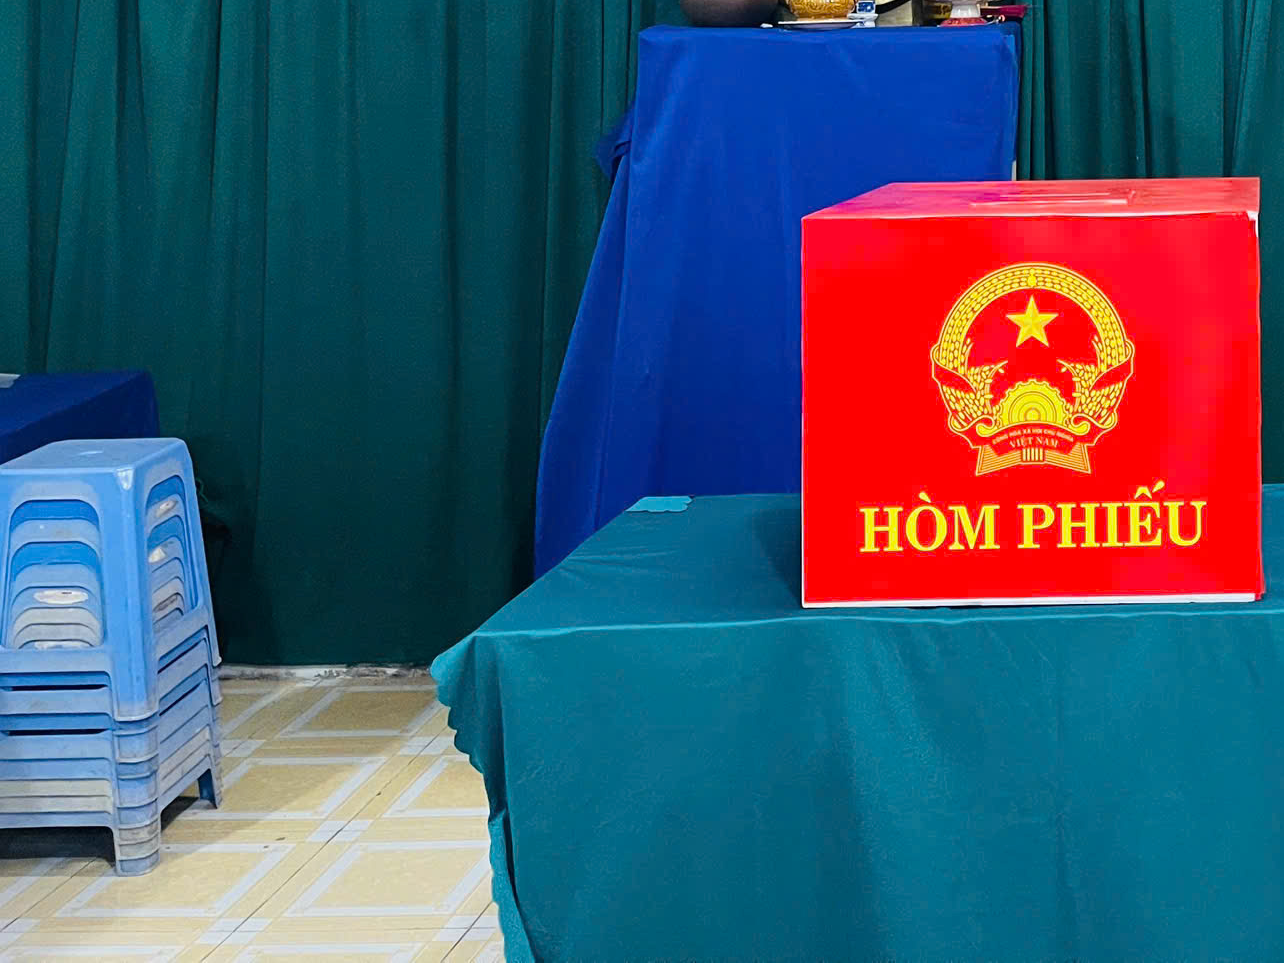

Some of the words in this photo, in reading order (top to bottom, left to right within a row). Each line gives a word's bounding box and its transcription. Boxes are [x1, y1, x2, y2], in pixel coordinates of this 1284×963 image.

[1036, 436, 1059, 449] NAM
[859, 492, 1001, 553] HÒM
[1017, 480, 1208, 550] PHIẾU
